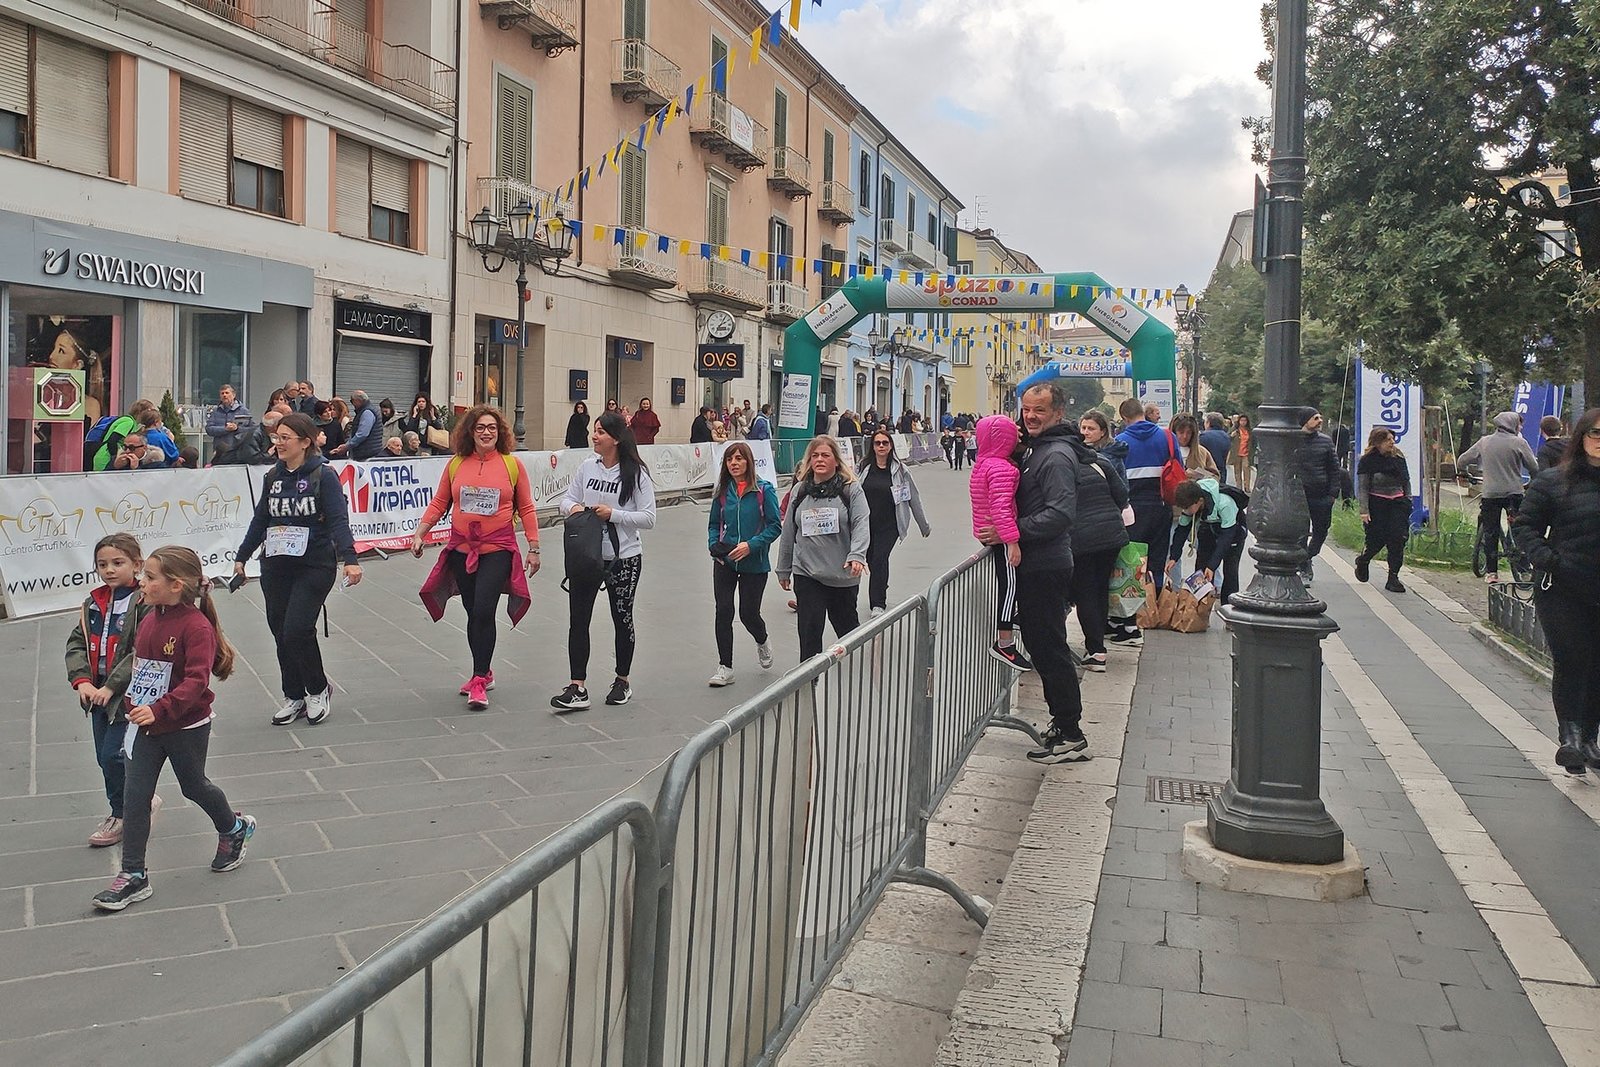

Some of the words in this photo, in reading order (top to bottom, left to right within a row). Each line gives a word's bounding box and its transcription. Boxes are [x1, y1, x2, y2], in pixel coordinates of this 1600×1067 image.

[77, 252, 206, 295] SWAROVSKI
[951, 297, 998, 306] CONAD
[375, 313, 414, 334] OPTICAL
[503, 323, 519, 339] OVS
[624, 342, 637, 356] OVS
[703, 352, 737, 367] OVS
[1069, 363, 1123, 371] INTERSPORT
[576, 379, 587, 389] OVS
[370, 465, 420, 488] METAL
[586, 478, 620, 494] PUMA
[373, 487, 433, 513] IMPIANTI
[350, 522, 397, 537] ERRAMENTI
